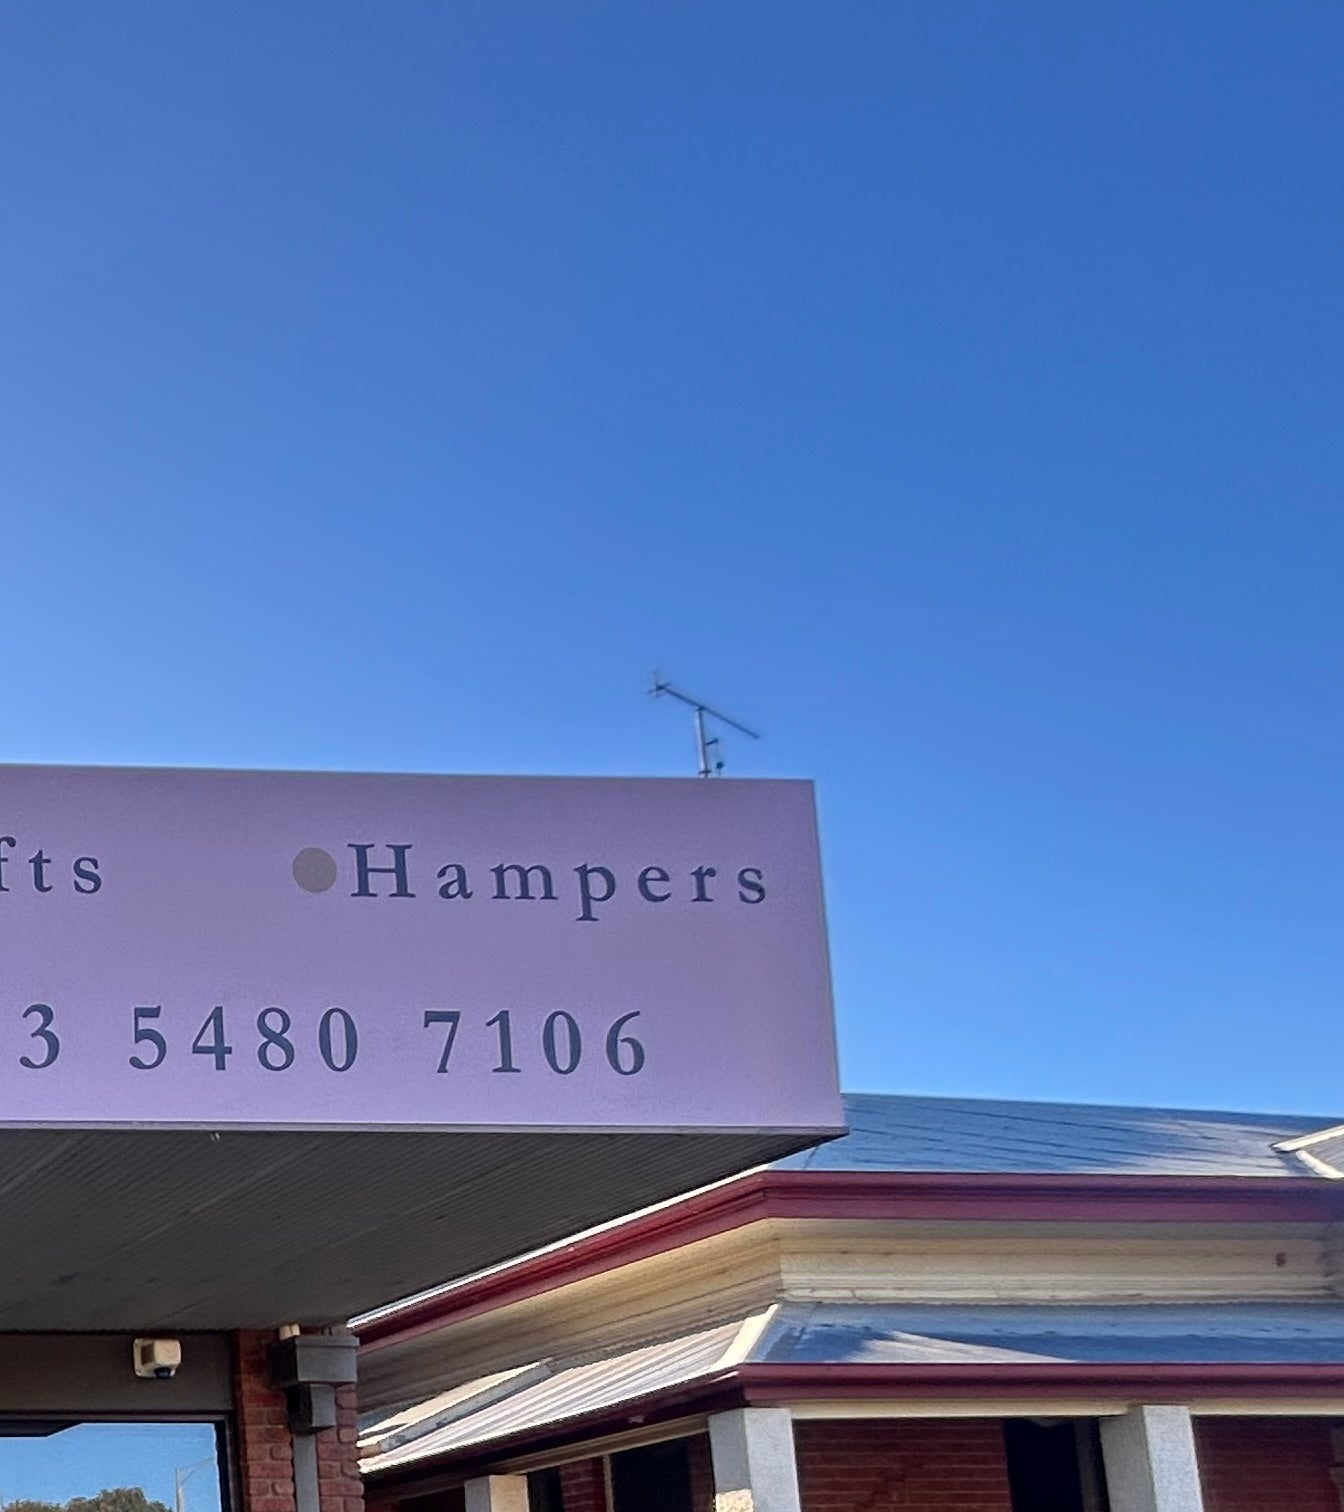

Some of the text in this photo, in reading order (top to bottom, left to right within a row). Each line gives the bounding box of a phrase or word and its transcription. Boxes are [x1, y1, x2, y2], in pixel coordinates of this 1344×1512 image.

[346, 842, 767, 923] Hampers
[127, 1004, 359, 1074] 5480
[422, 1008, 646, 1077] 7106
